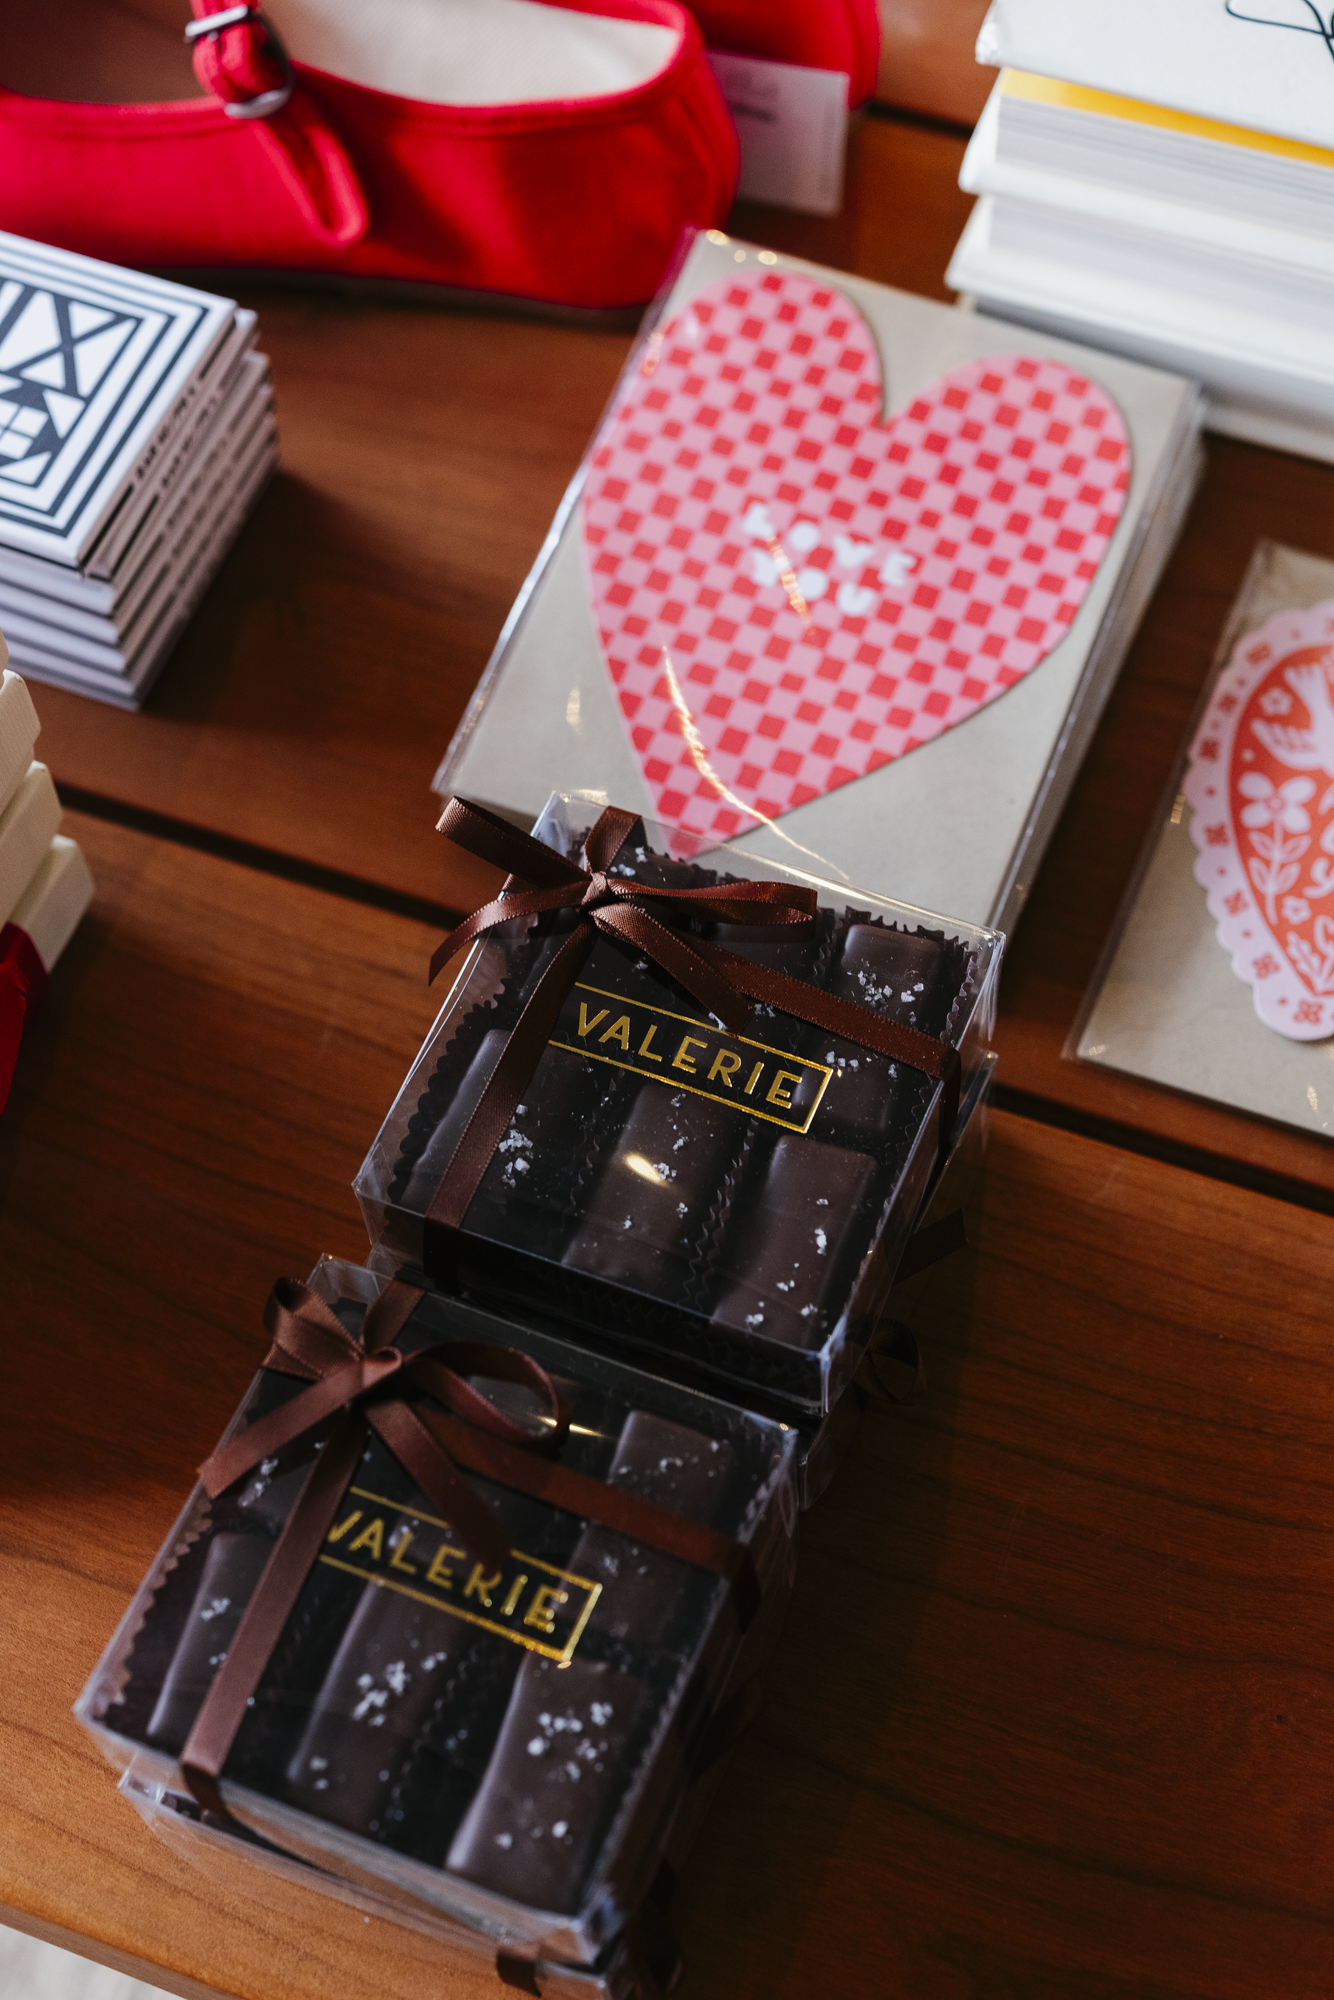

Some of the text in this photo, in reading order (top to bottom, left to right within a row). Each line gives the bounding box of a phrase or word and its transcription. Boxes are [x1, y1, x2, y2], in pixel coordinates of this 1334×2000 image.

[743, 504, 915, 587] LOVE
[753, 550, 875, 616] YOU
[577, 1001, 802, 1109] VALERIE
